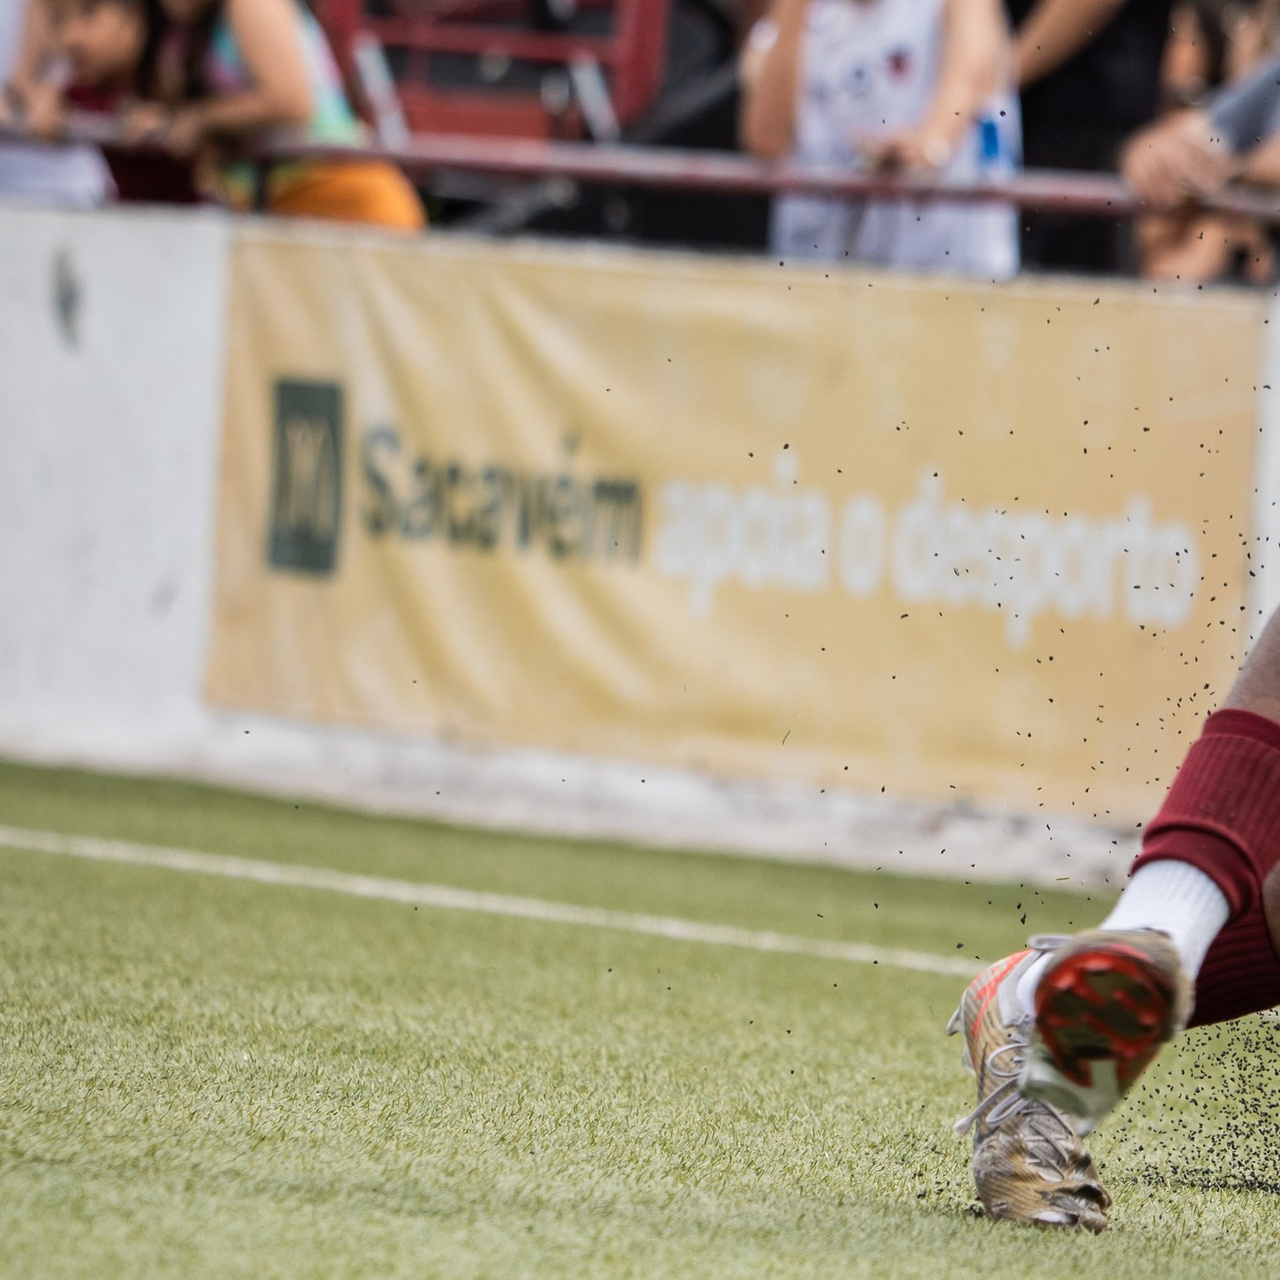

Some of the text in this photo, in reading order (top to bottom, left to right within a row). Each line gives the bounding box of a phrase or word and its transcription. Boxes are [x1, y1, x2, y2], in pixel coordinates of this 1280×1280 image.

[654, 451, 830, 618] apoia
[838, 489, 886, 600] o
[894, 465, 1198, 651] desporto
